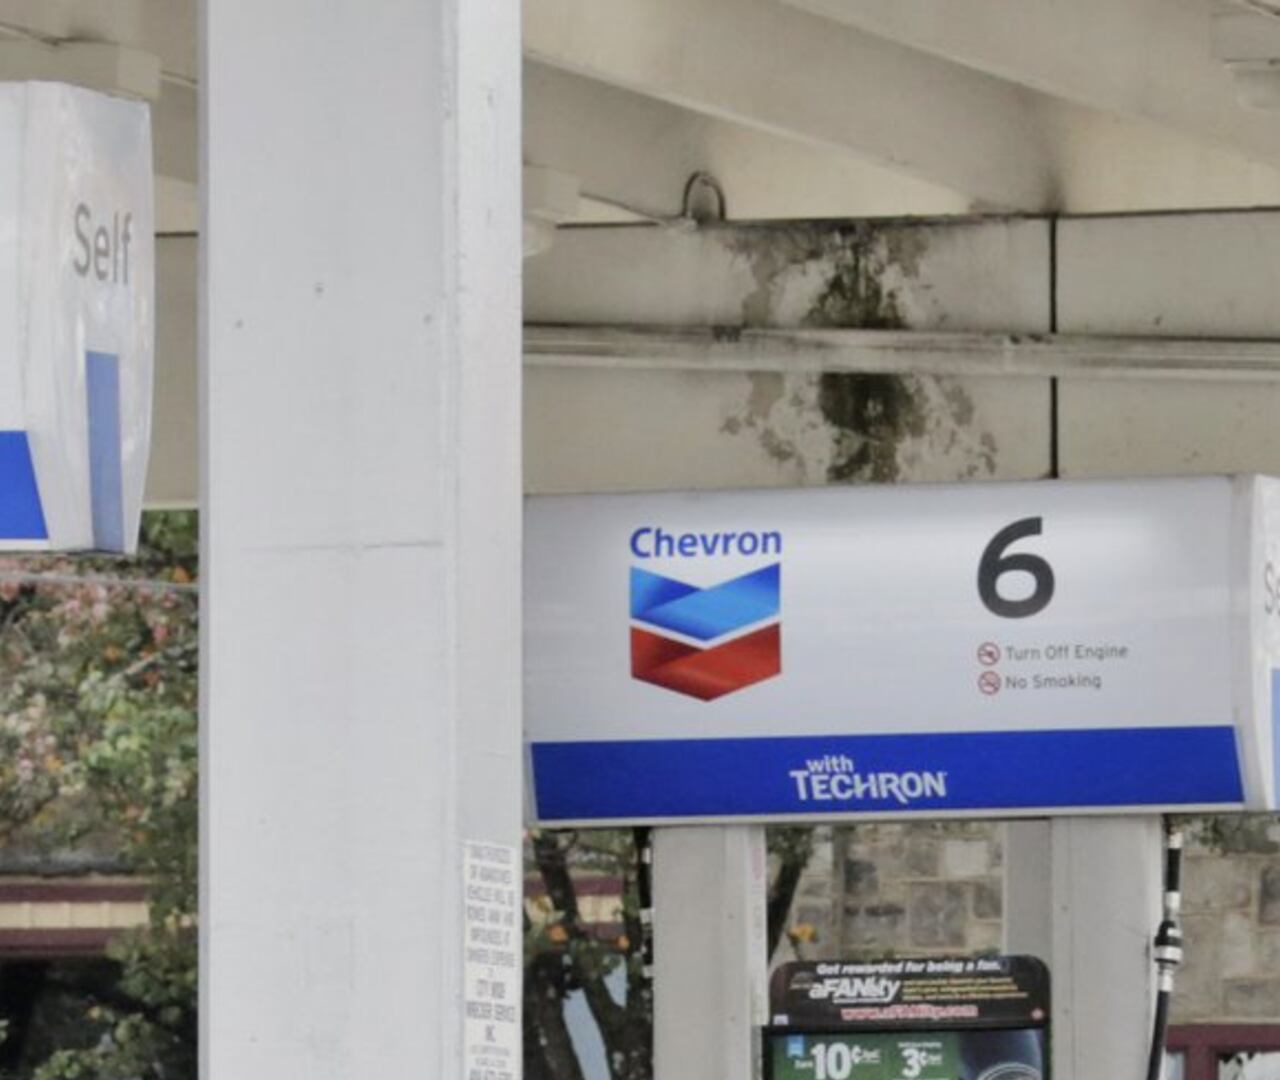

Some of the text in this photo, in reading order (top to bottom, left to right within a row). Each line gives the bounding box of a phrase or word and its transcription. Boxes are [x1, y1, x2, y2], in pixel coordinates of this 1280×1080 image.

[73, 202, 132, 285] Self
[630, 527, 782, 559] Chevron
[977, 517, 1055, 619] 6
[1006, 644, 1129, 661] Turn Off Engine
[1005, 674, 1101, 690] No Smoking
[806, 755, 854, 773] with
[789, 770, 947, 804] TECHRON
